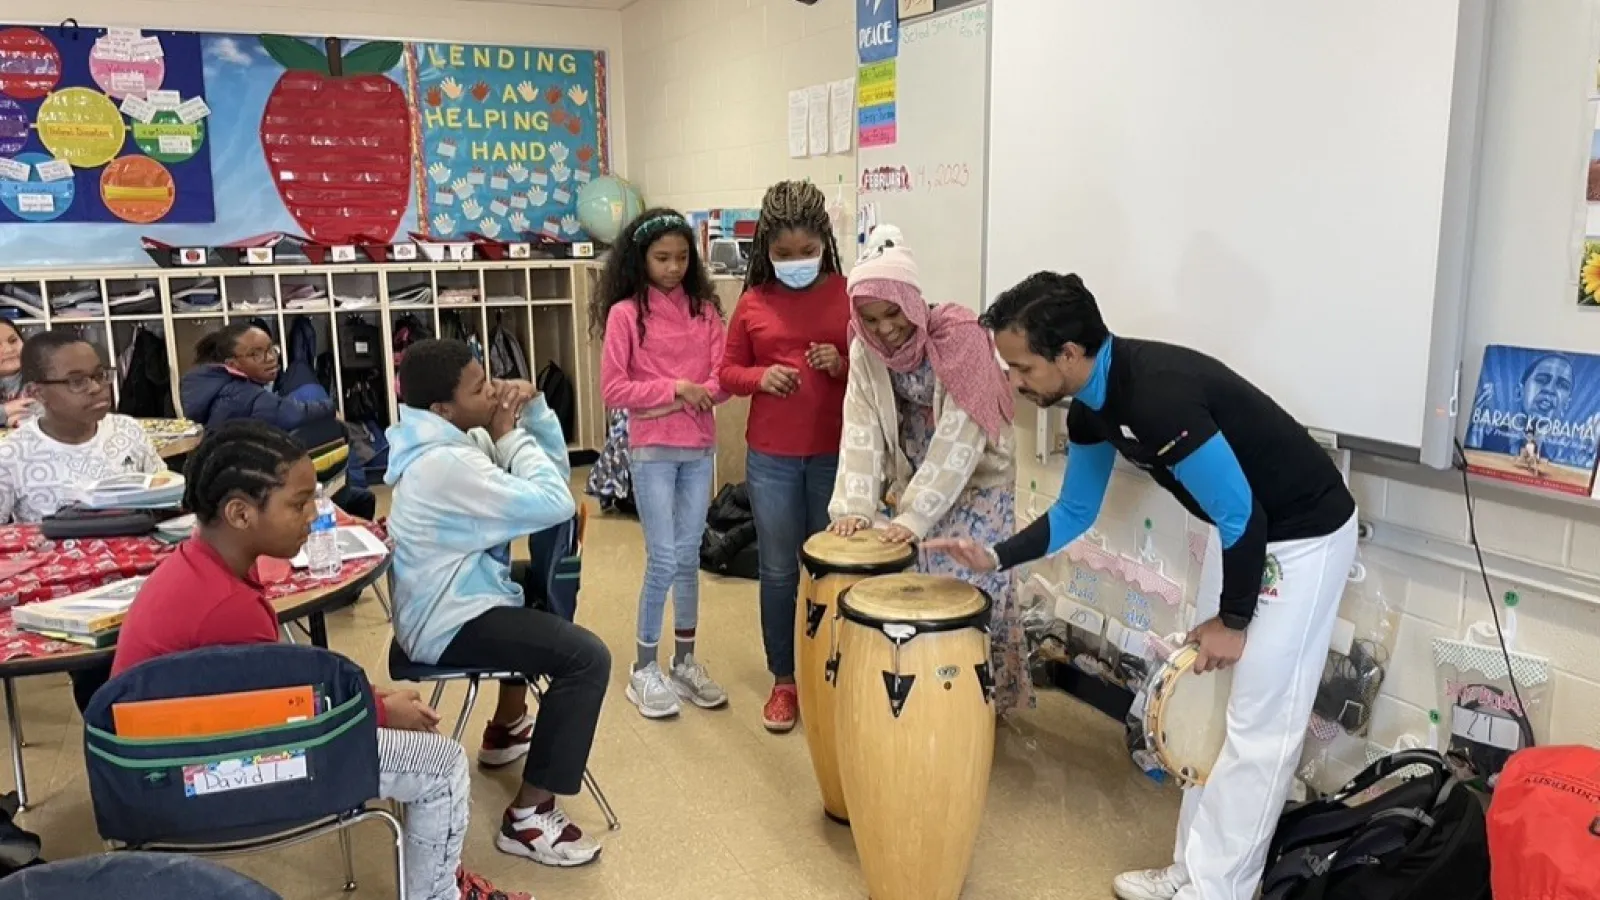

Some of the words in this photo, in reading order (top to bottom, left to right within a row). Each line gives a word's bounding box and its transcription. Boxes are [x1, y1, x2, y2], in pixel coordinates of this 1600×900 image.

[859, 20, 893, 49] PEACE
[428, 44, 577, 74] LENDING
[502, 83, 518, 104] A
[425, 107, 548, 131] HELPING
[471, 141, 546, 161] HAND
[863, 170, 908, 190] FEBRUARY
[1473, 407, 1536, 431] BARACK
[1535, 416, 1596, 441] OBAMA
[204, 765, 264, 790] David
